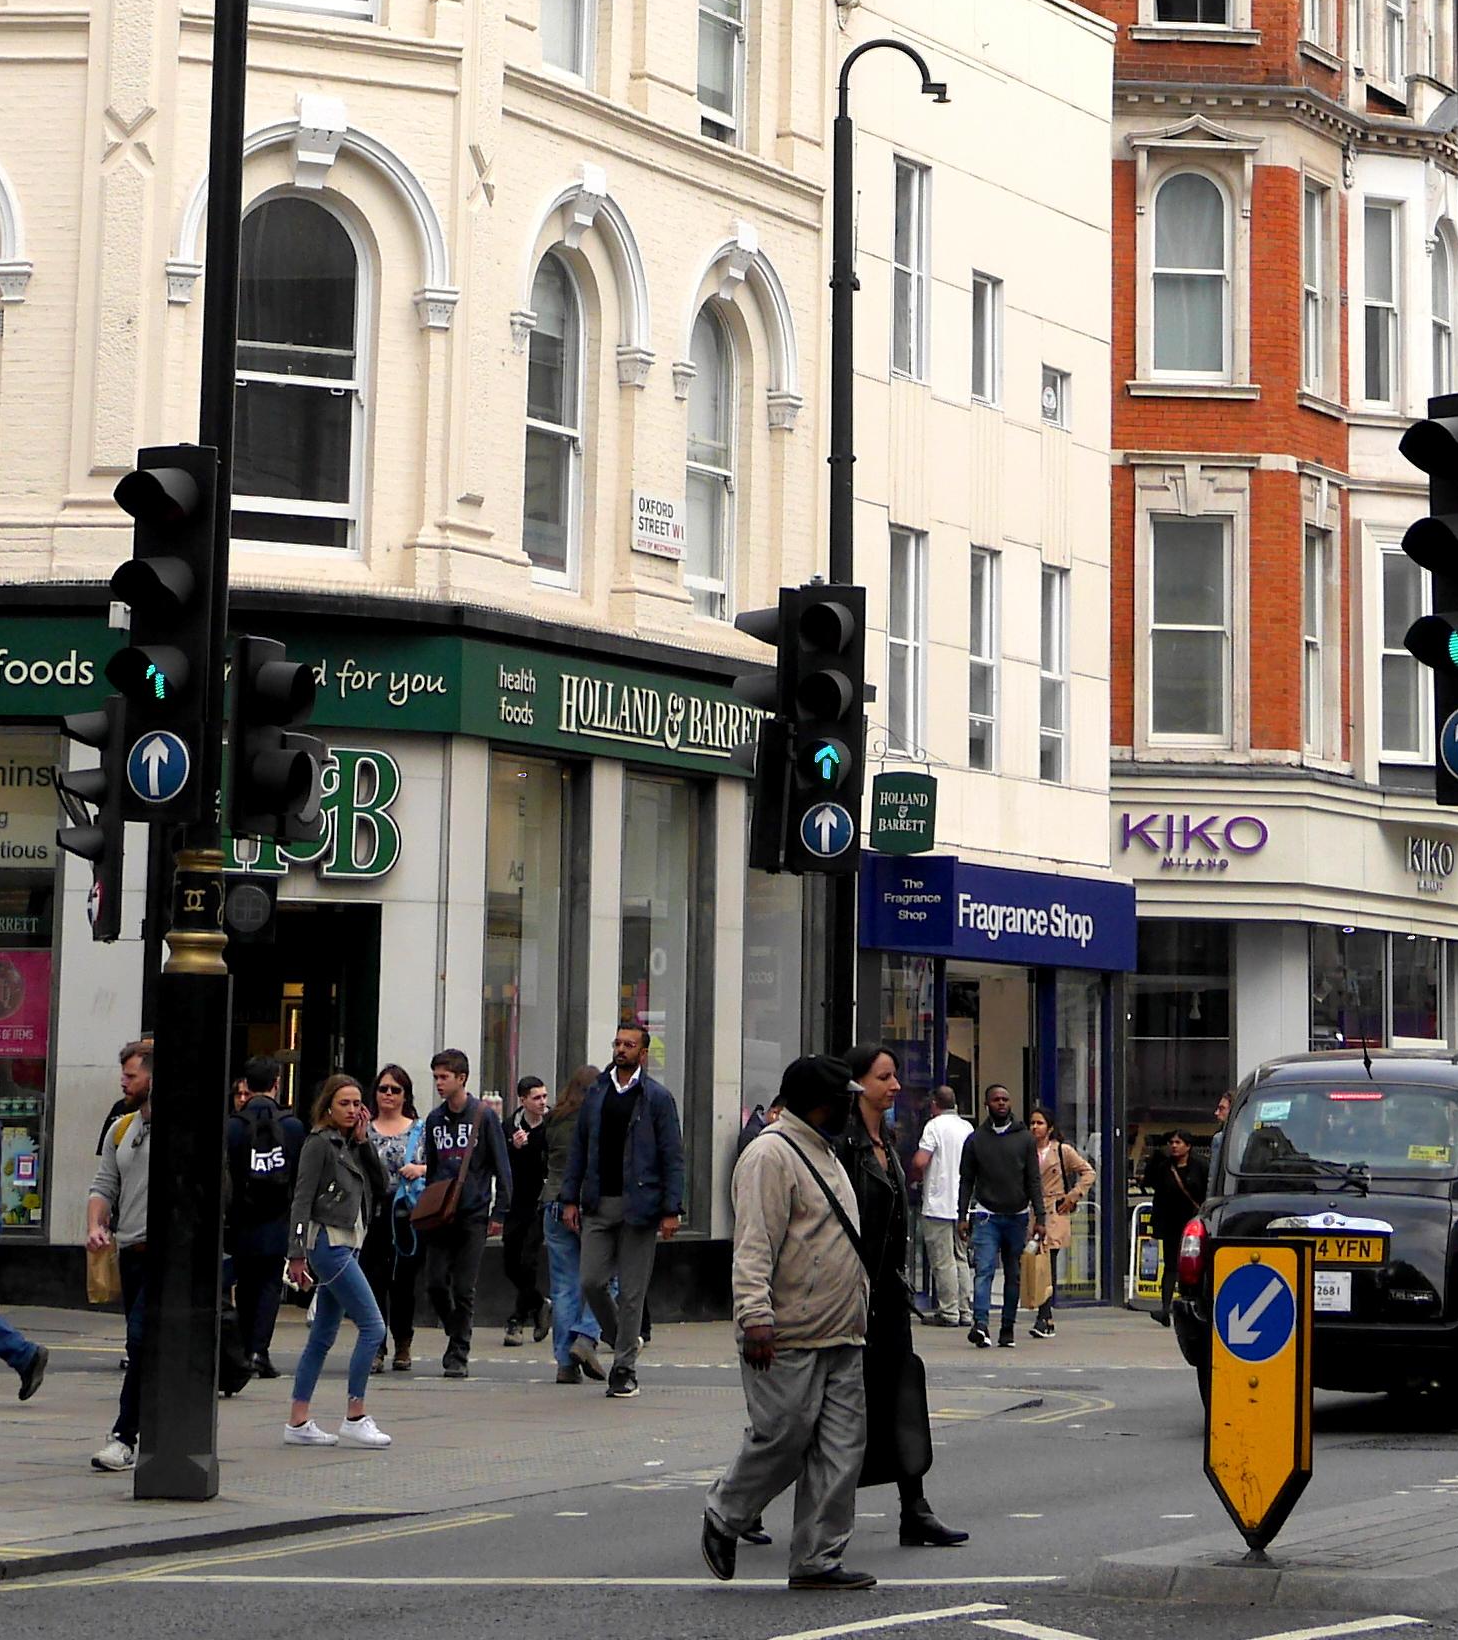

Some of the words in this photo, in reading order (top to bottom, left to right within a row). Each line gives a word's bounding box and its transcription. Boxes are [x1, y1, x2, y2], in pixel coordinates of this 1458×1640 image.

[638, 497, 674, 519] OXFORD
[638, 515, 670, 537] STREET
[672, 523, 684, 541] W1
[336, 659, 382, 698] for
[388, 671, 447, 706] you
[499, 665, 536, 693] health
[499, 697, 534, 726] foods
[558, 674, 661, 738] HOLLAND
[664, 692, 685, 750] &
[688, 697, 775, 750] BARRET
[879, 792, 929, 808] HOLLAND
[897, 805, 909, 819] &
[878, 818, 927, 834] BARRETT
[1122, 813, 1269, 854] KIKO
[1161, 857, 1229, 871] MILANO
[1406, 836, 1454, 877] KIKO
[902, 879, 924, 889] The
[884, 893, 941, 904] Fragrance
[898, 910, 927, 921] Shop
[958, 893, 1049, 941] Fragrance
[1050, 903, 1093, 948] Shop
[2, 1029, 9, 1040] OF
[13, 1029, 34, 1040] ITEMS
[434, 1136, 478, 1150] WOO
[1335, 1240, 1371, 1257] YFN
[1316, 1286, 1341, 1297] 2681
